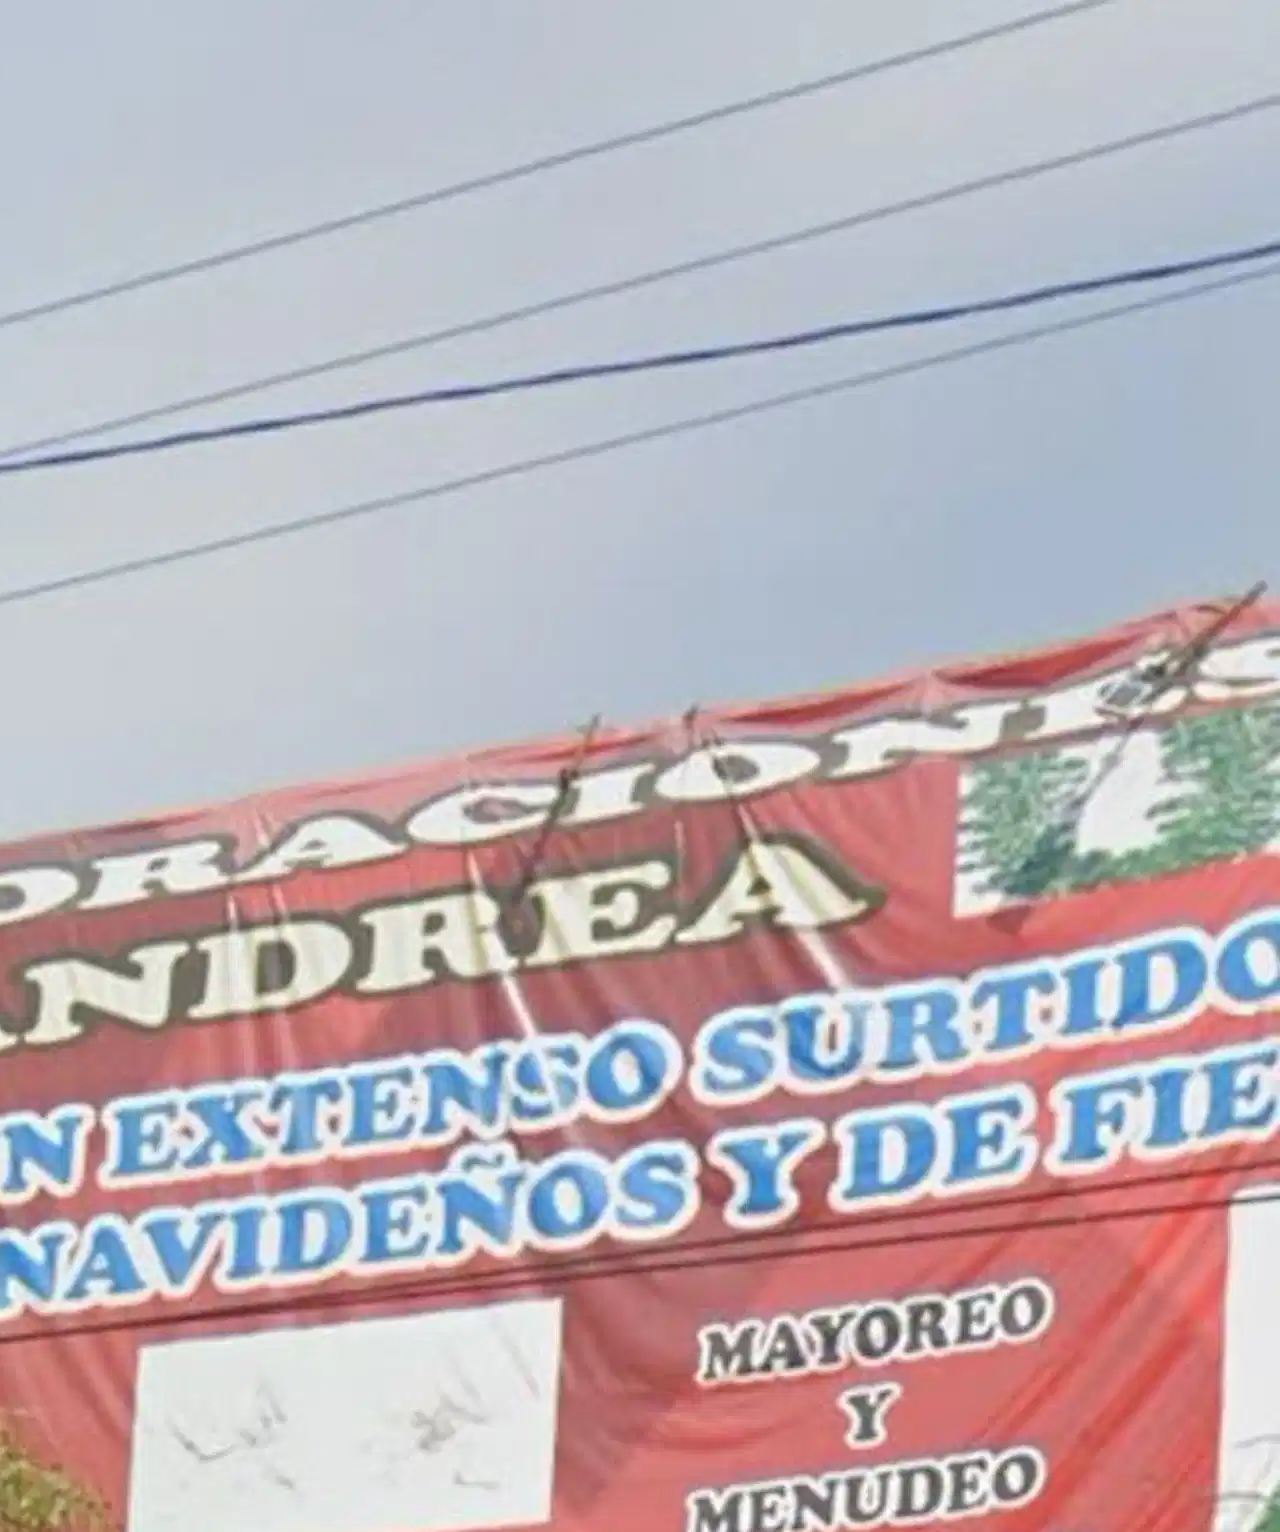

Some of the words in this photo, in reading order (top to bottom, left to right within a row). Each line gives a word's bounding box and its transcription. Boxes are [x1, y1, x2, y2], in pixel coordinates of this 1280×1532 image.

[104, 1024, 674, 1176] EXTENSO
[698, 913, 1280, 1096] SURTIDO
[722, 1128, 816, 1219] Y
[842, 1093, 1030, 1200] DE
[700, 1282, 1048, 1382] MAYOREO
[843, 1386, 897, 1447] Y
